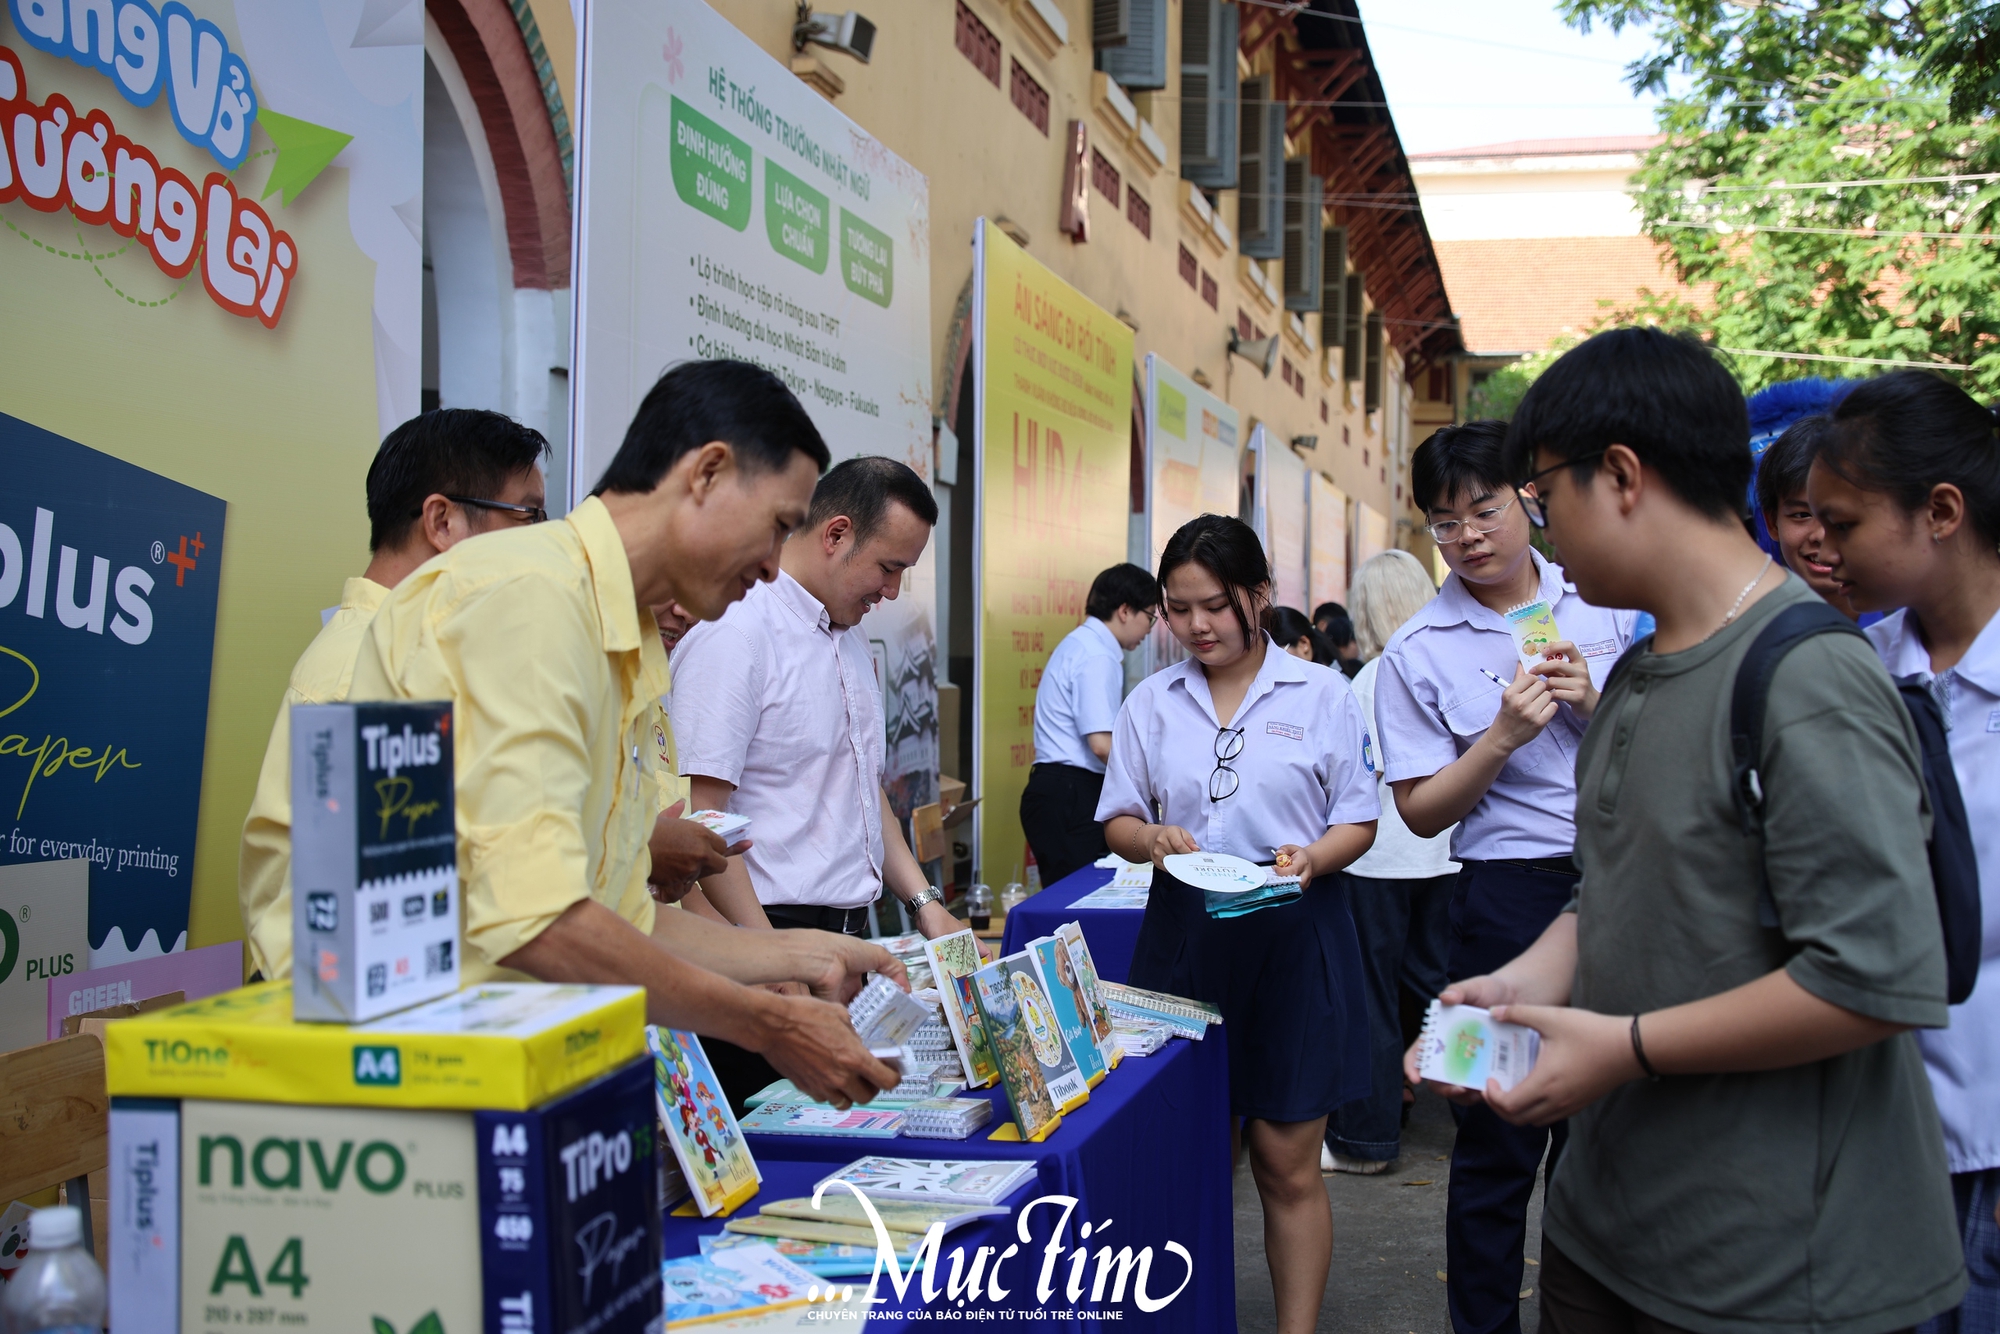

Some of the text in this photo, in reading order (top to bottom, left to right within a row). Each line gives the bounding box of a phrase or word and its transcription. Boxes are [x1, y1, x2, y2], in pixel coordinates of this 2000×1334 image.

[167, 12, 252, 160] Vở
[677, 119, 747, 184] ĐỊNH HƯỚNG
[708, 66, 727, 111] HỆ
[729, 85, 773, 136] THỐNG
[774, 114, 821, 169] TRƯỜNG
[821, 149, 849, 191] NHẬT
[695, 171, 730, 212] ĐÚNG
[697, 254, 840, 339] Lộ trình học tập rõ ràng sau THPT
[697, 293, 847, 375] Định hướng du học Nhật Bản từ sớm
[696, 333, 712, 360] Cơ
[813, 378, 844, 408] Nagoya
[849, 390, 880, 418] Fukuoka
[360, 722, 442, 779] Tiplus
[9, 827, 180, 878] for everyday printing
[26, 953, 74, 982] PLUS
[68, 979, 132, 1015] GREEN
[355, 1048, 398, 1081] A4
[197, 1133, 465, 1200] navo PLUS
[491, 1123, 529, 1157] A4
[560, 1129, 632, 1203] TiPro
[132, 1140, 160, 1231] Tiplus
[209, 1234, 310, 1299] A4
[500, 1290, 535, 1334] Ti
